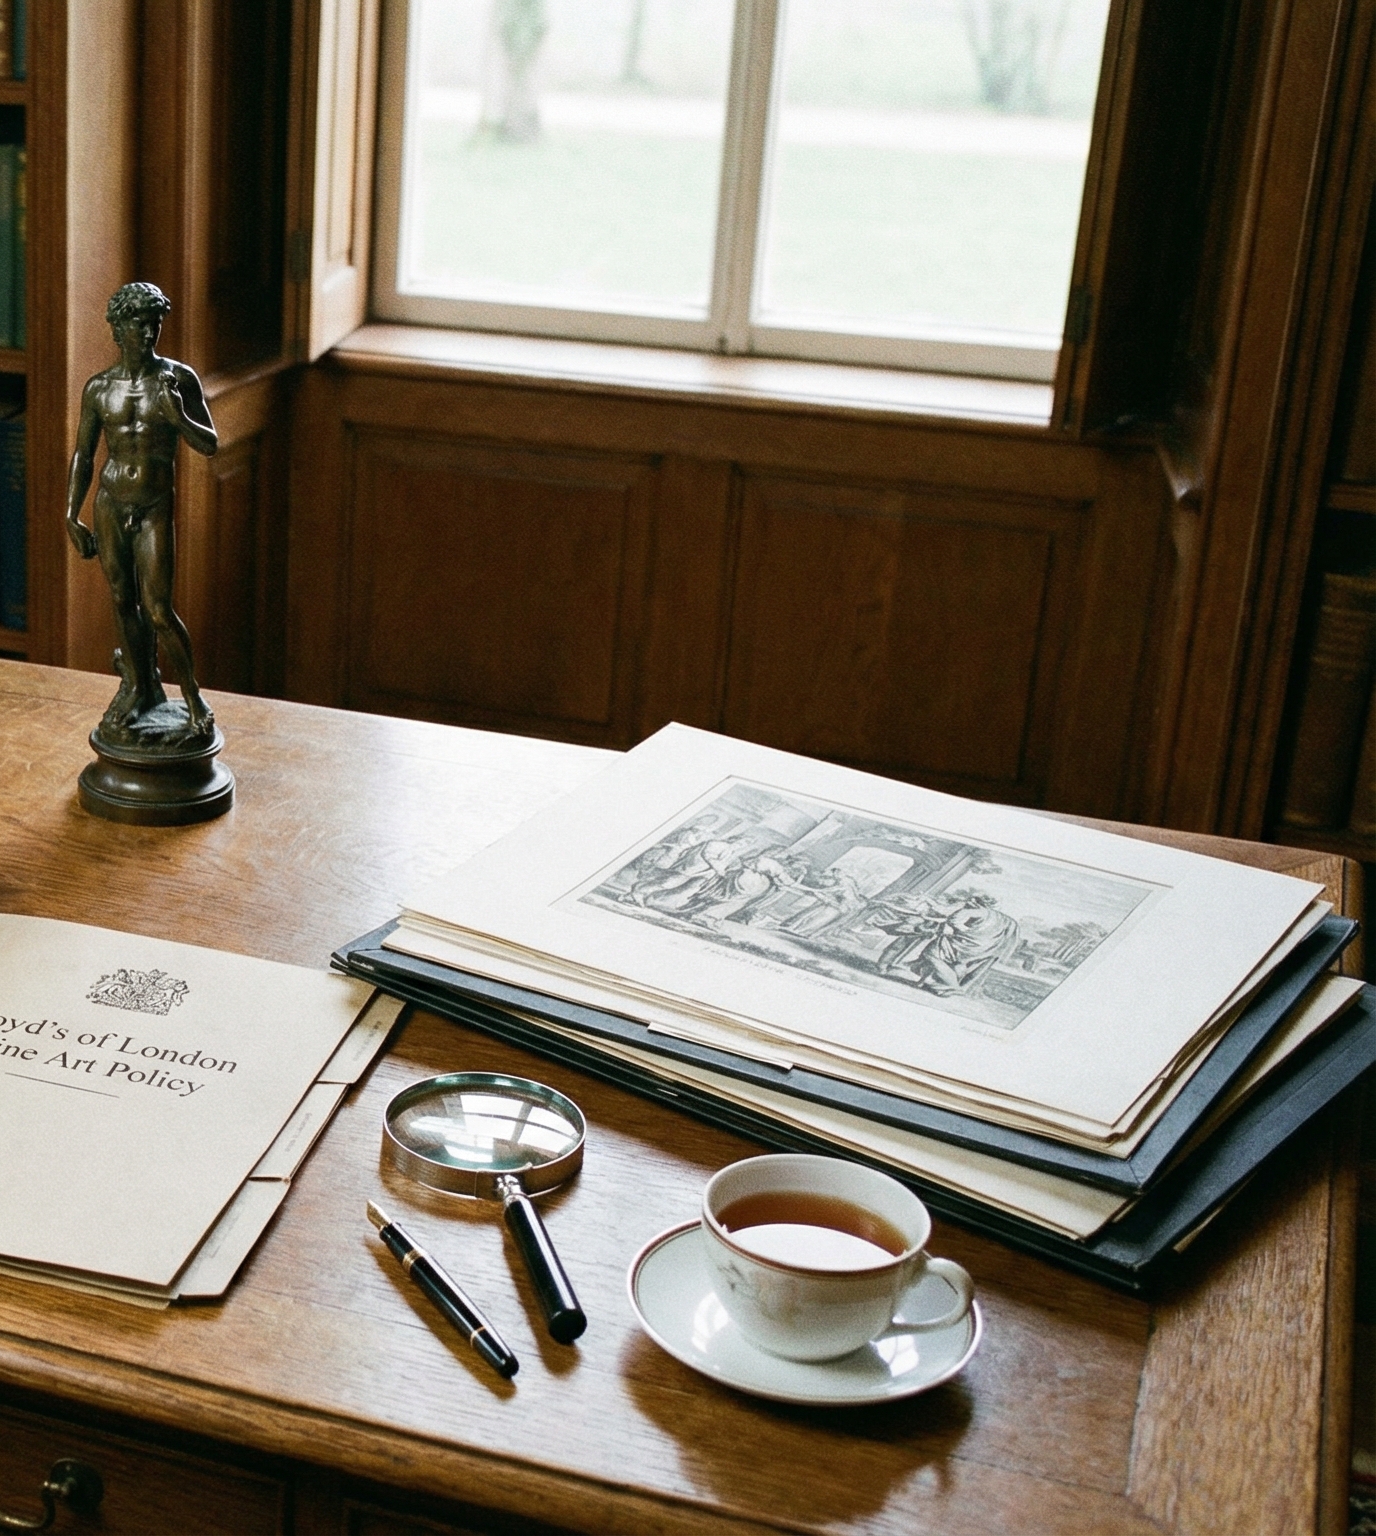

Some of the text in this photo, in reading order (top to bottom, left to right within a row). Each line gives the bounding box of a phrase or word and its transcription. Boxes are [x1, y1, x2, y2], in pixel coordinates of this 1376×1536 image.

[43, 1051, 97, 1074] Art
[105, 1061, 206, 1098] Policy
[77, 1031, 119, 1049] of
[116, 1036, 239, 1074] London
